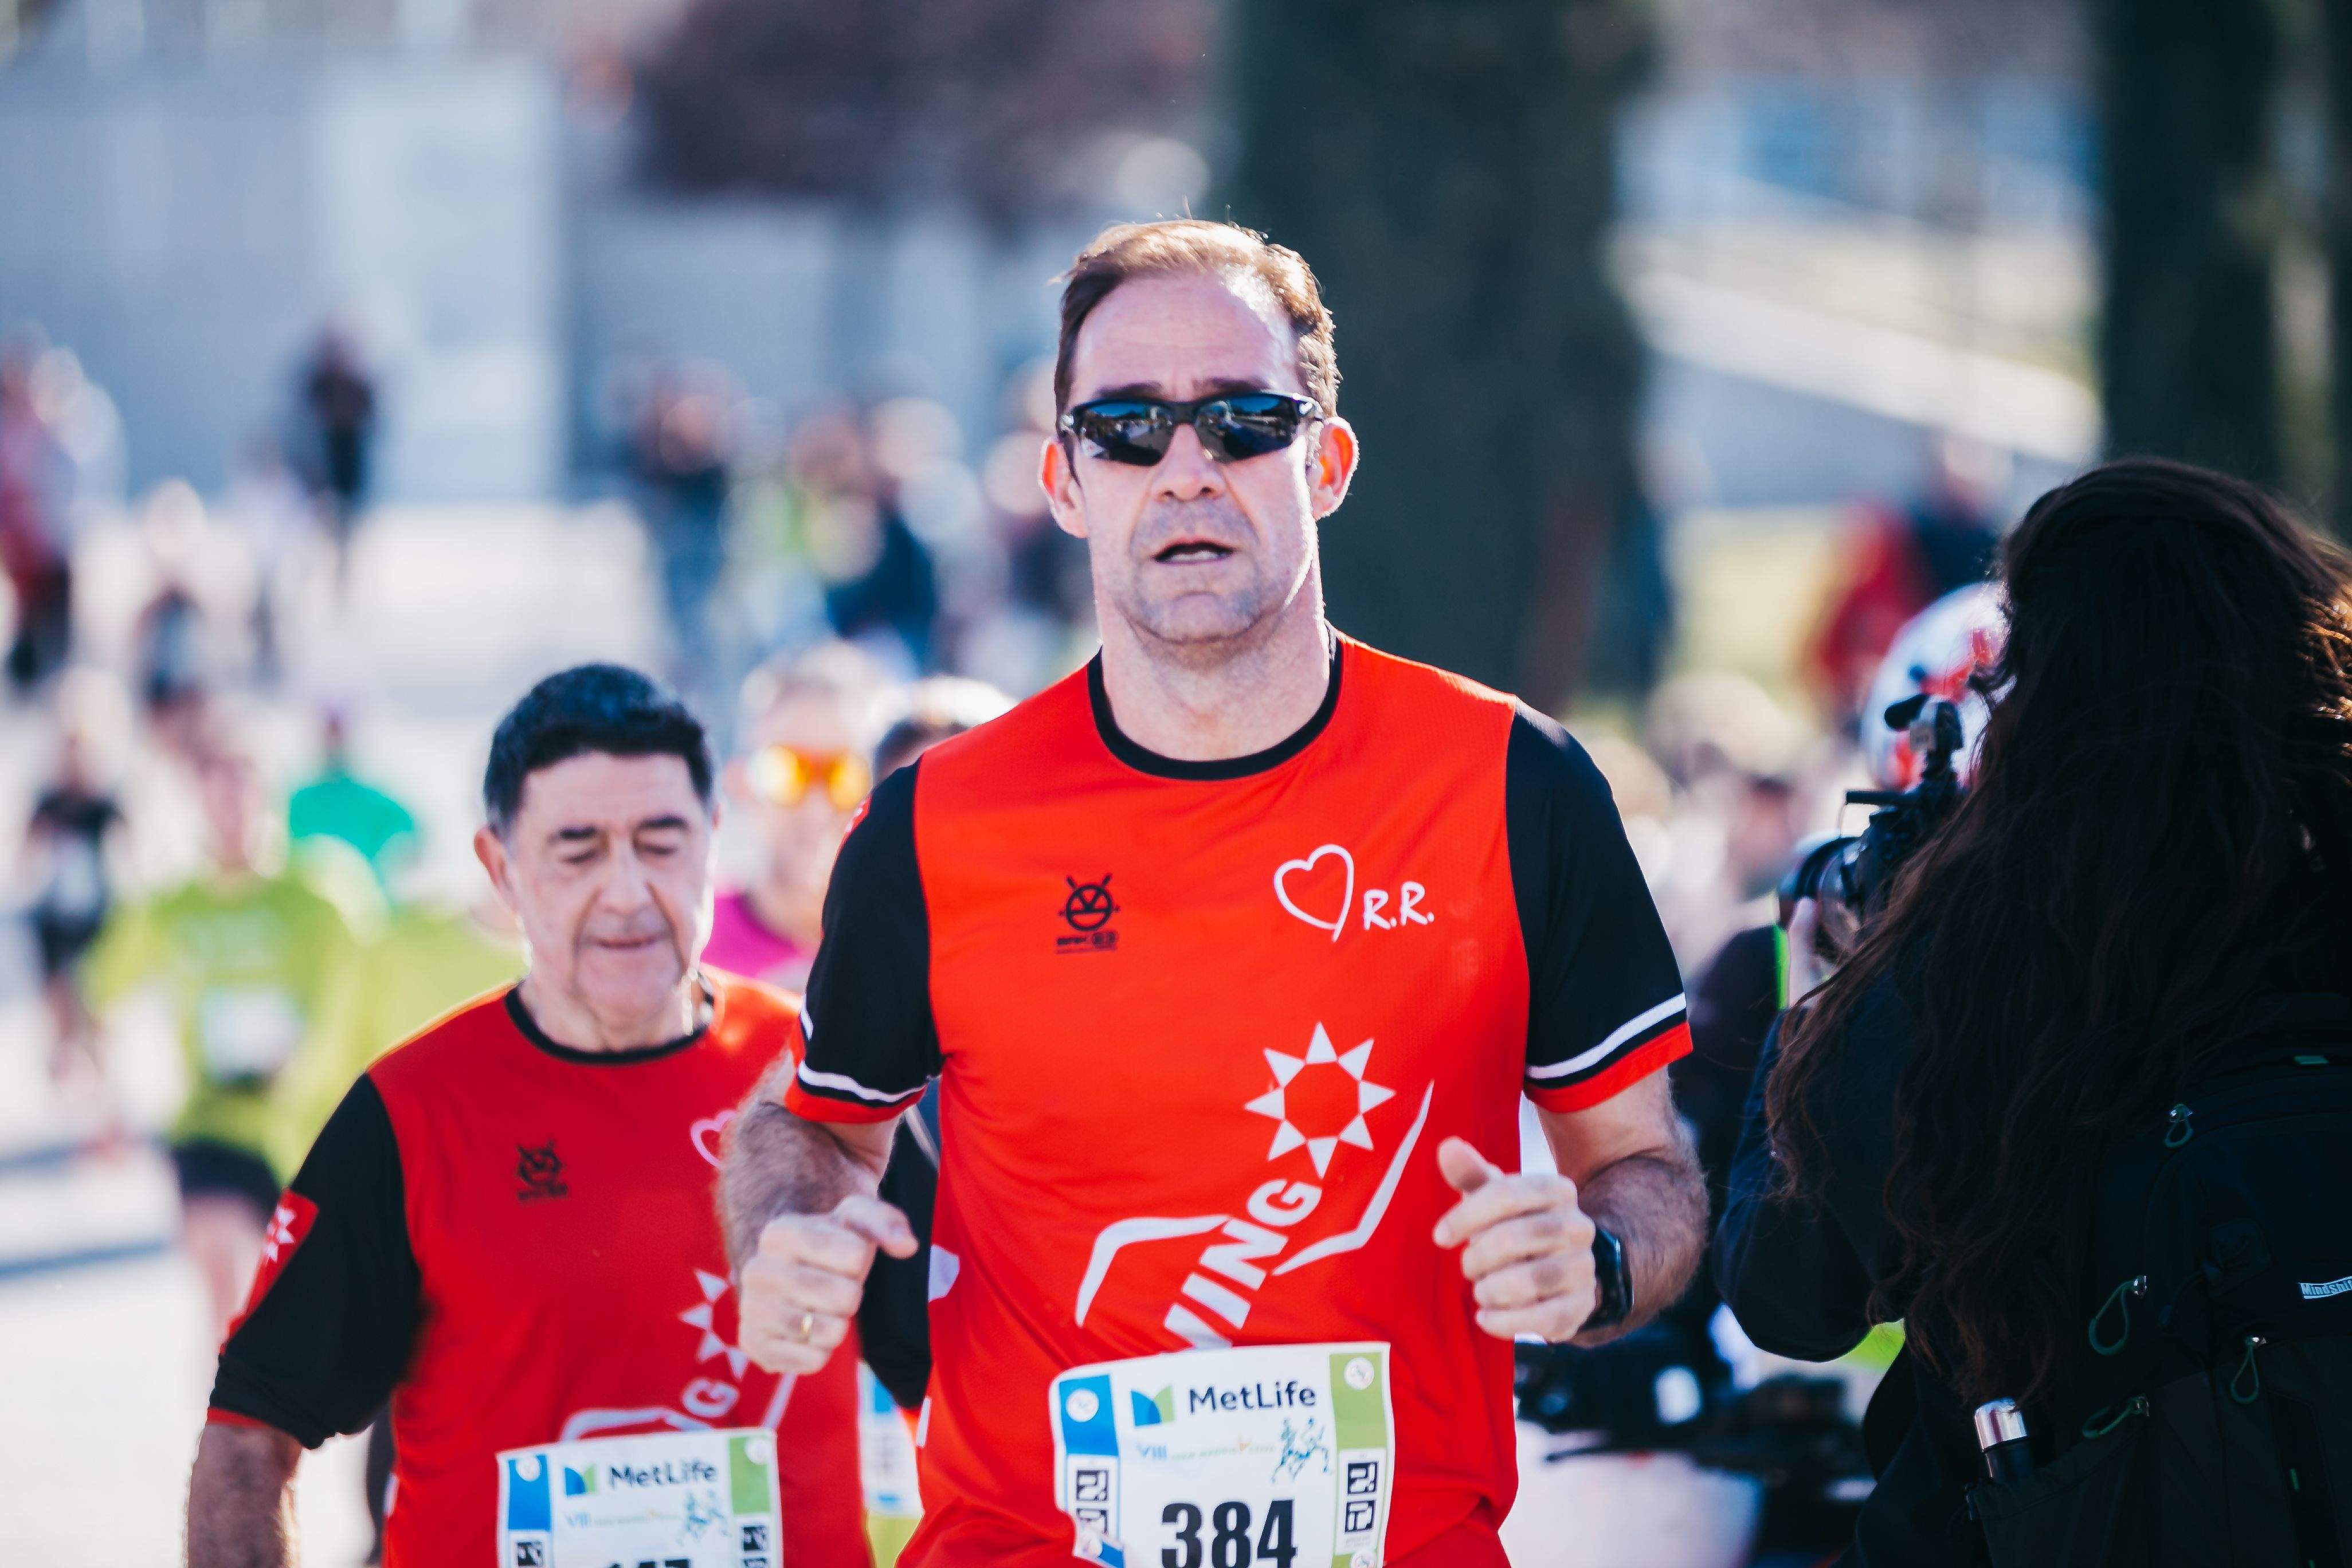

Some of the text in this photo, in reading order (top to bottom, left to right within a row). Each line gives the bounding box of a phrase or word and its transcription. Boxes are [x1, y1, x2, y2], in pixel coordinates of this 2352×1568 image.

[1363, 881, 1434, 930] R.R.
[1190, 1381, 1316, 1414] MetLife
[610, 1457, 716, 1488] MetLife
[1162, 1499, 1298, 1568] 384
